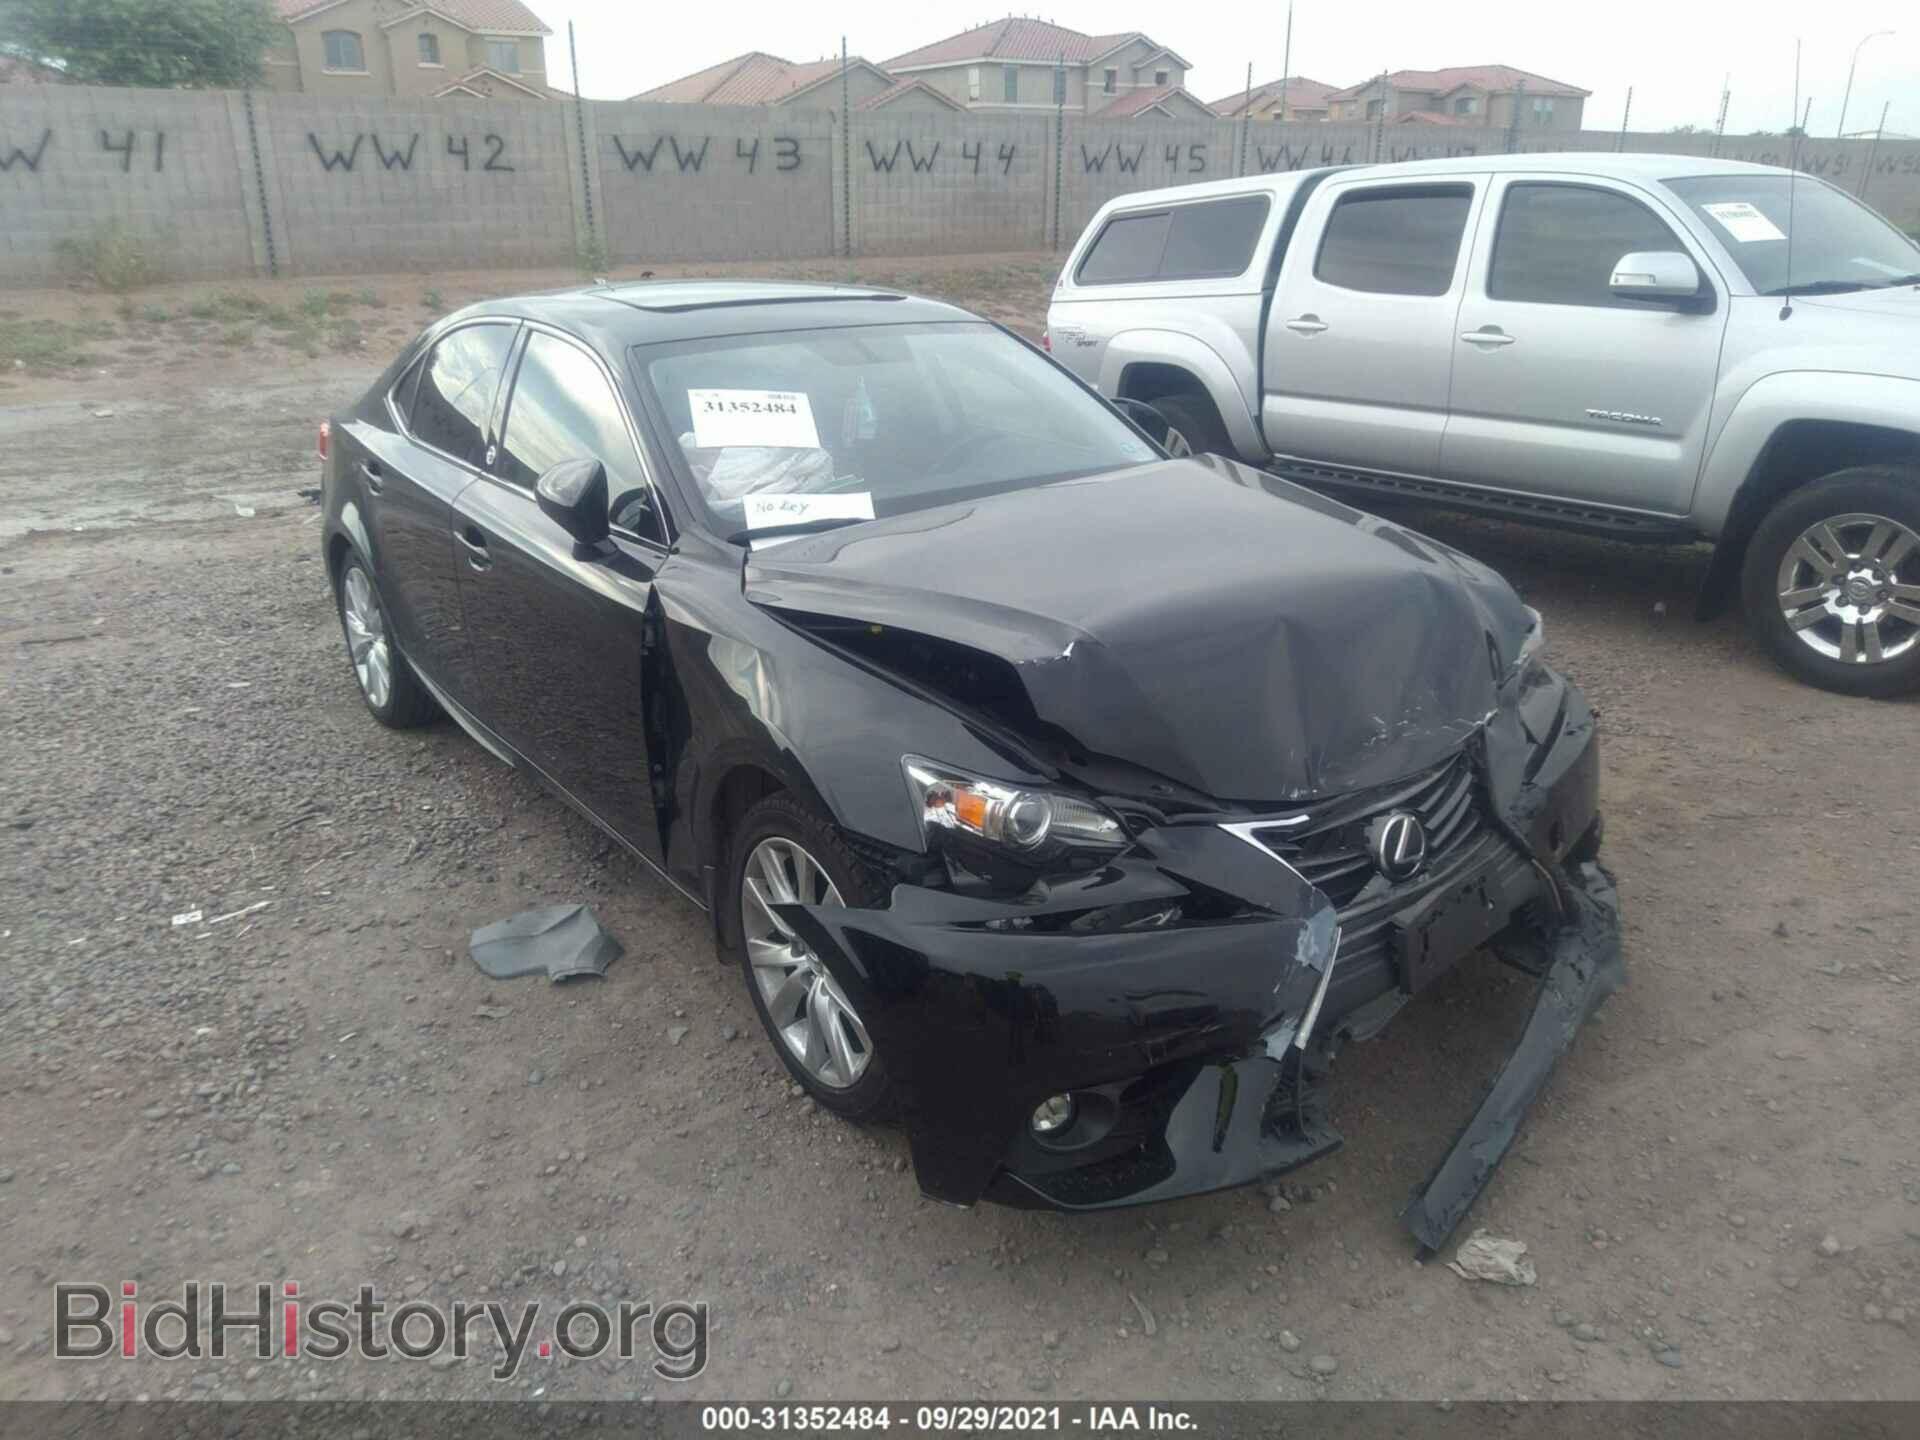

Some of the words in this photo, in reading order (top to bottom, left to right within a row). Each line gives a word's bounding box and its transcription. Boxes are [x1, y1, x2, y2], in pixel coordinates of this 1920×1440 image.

[100, 129, 164, 173] 41
[307, 132, 420, 172] WW
[447, 133, 515, 172] 42
[613, 135, 710, 174] WW
[736, 137, 802, 174] 43
[866, 140, 941, 174] WW
[962, 141, 1016, 175] 44
[1080, 143, 1145, 174] WW
[1165, 144, 1206, 174] 45
[1257, 144, 1309, 171] WW
[704, 401, 797, 414] 31352484
